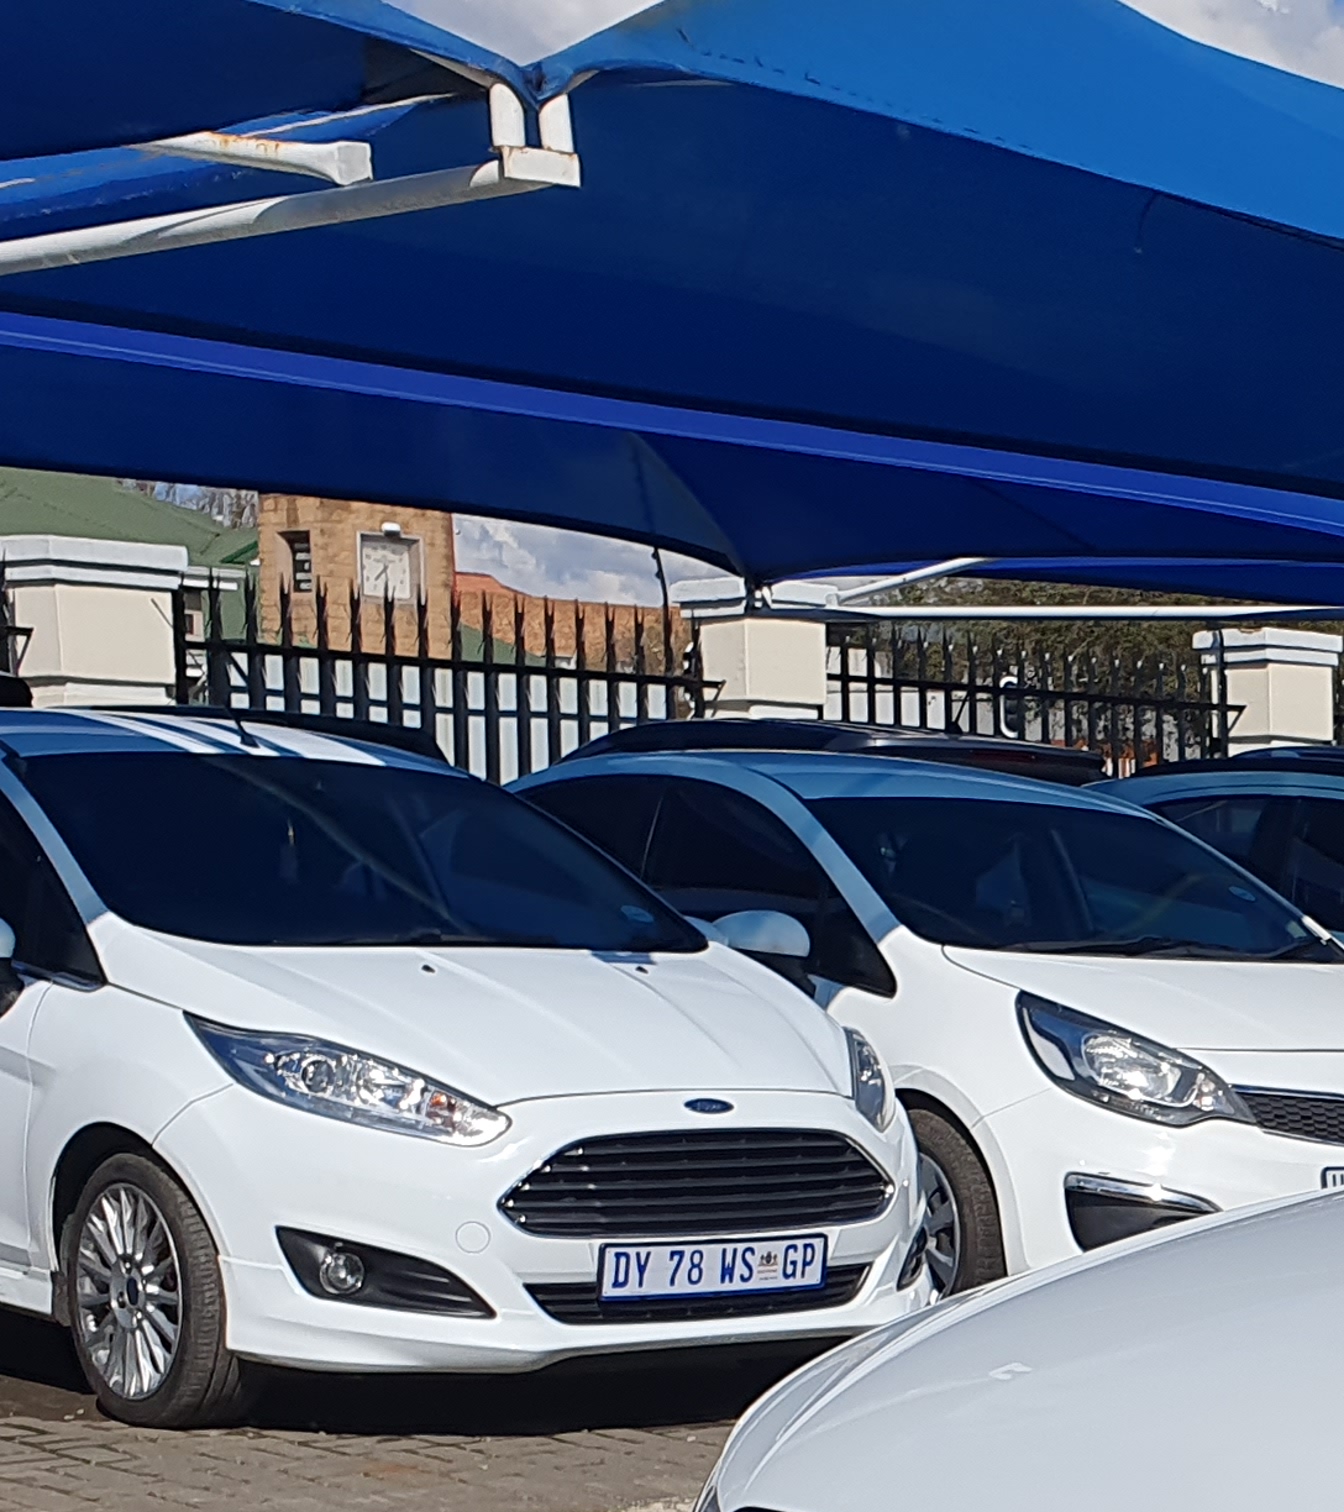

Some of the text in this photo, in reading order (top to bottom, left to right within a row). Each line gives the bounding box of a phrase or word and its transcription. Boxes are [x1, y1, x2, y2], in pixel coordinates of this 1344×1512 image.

[611, 1243, 816, 1289] DY 78 WS GP
